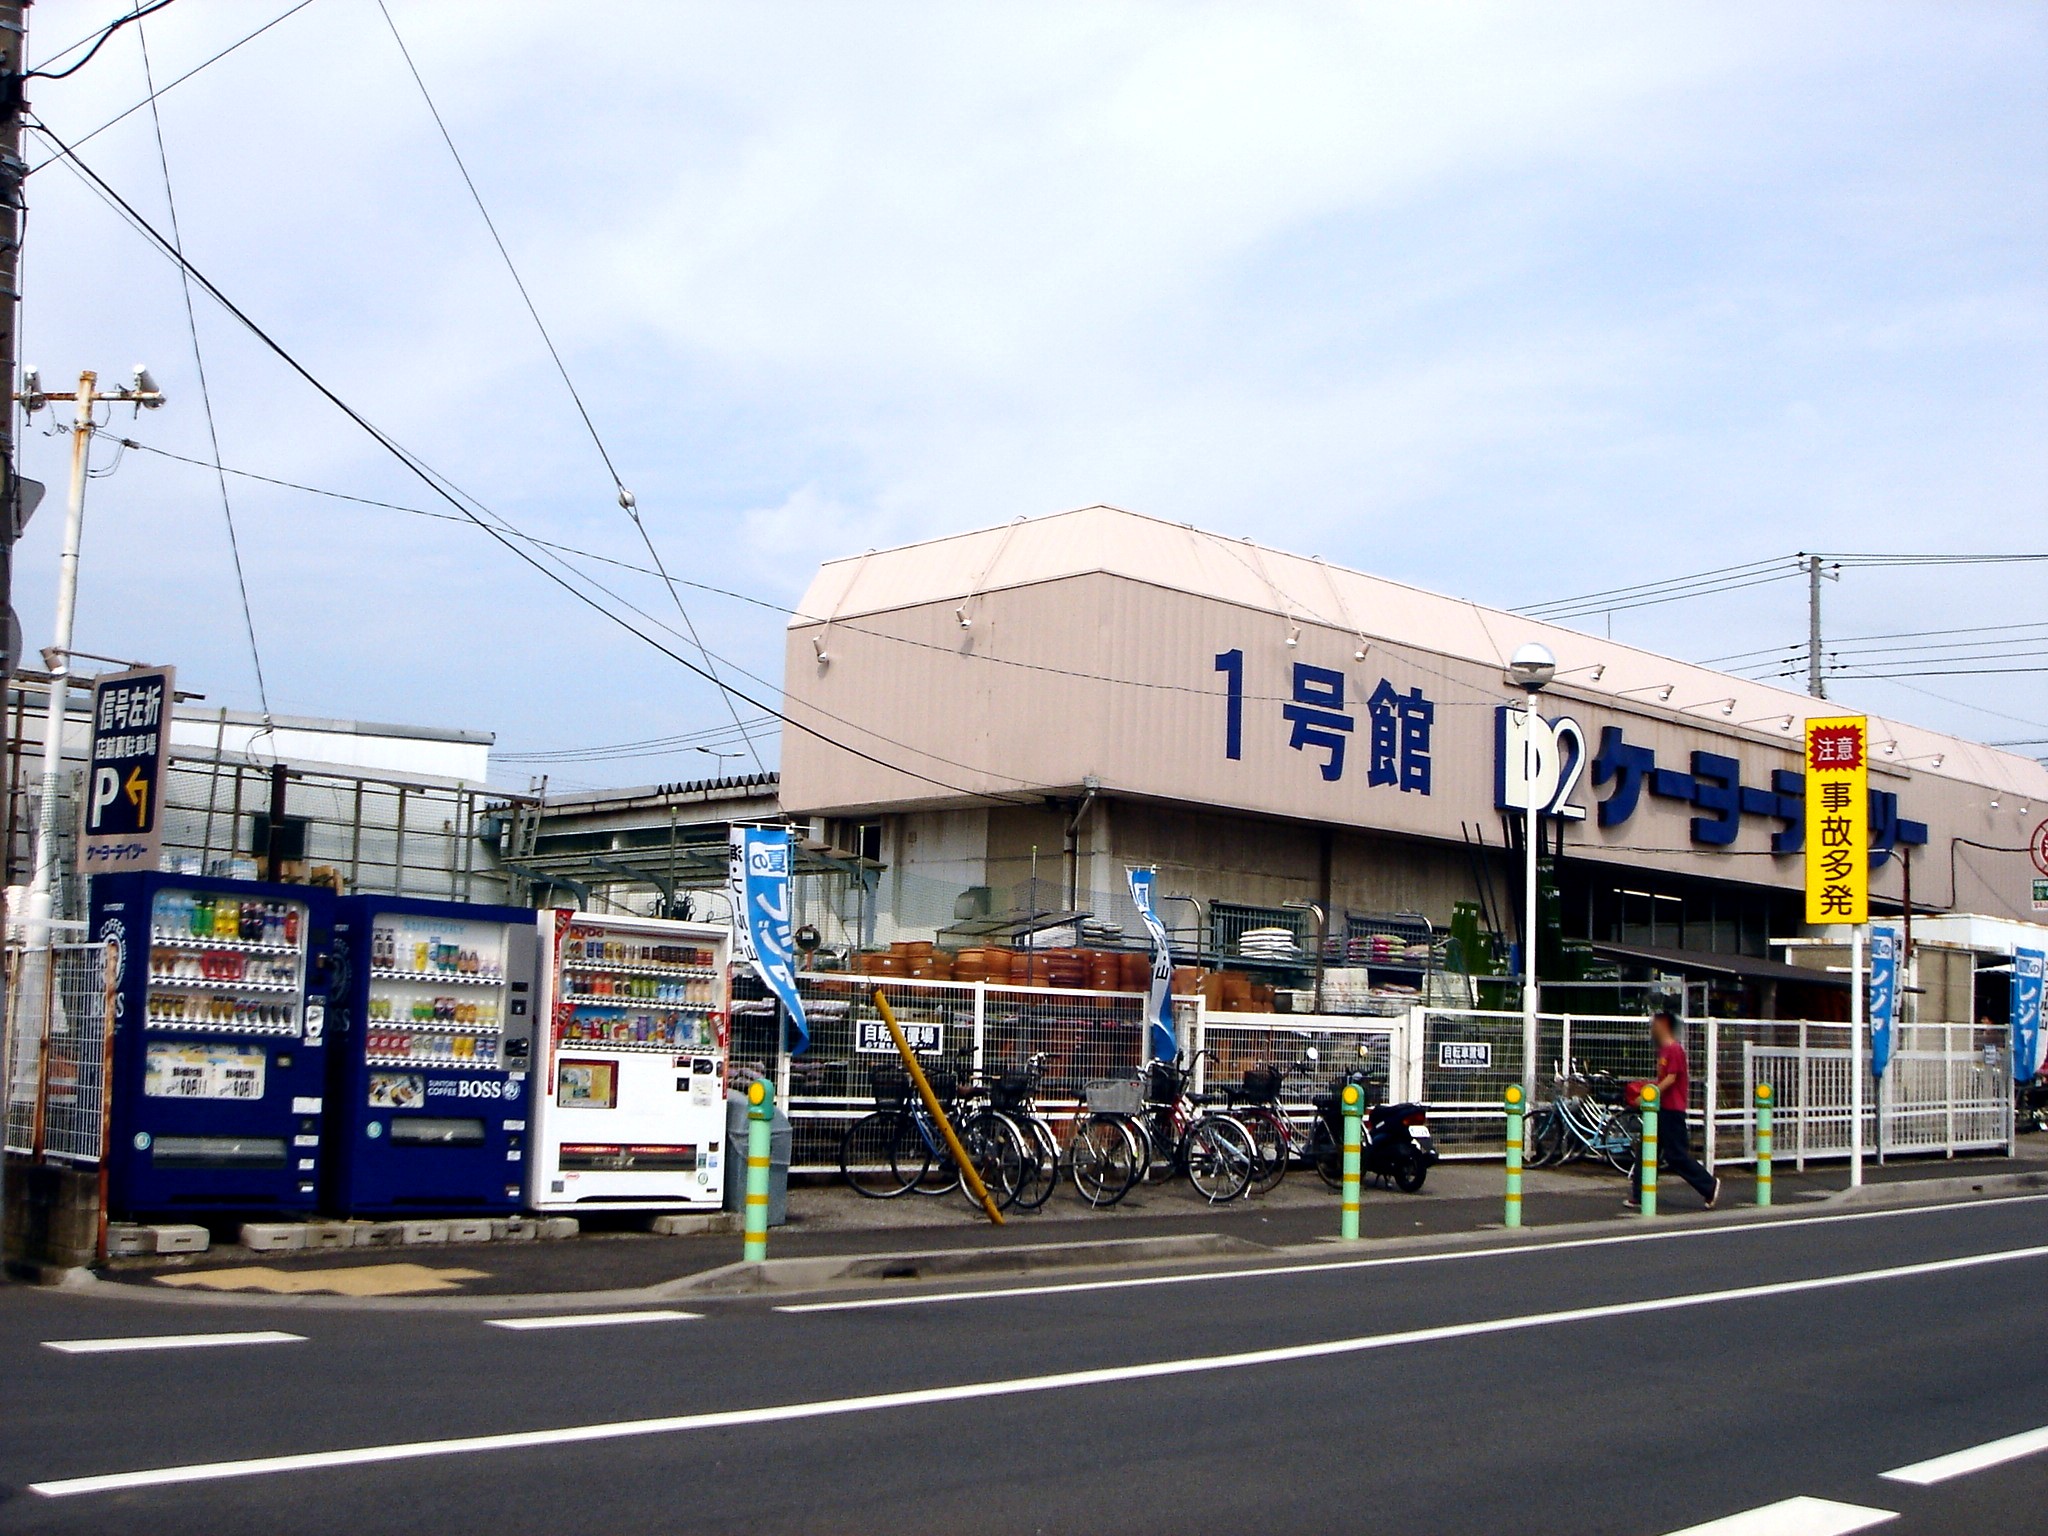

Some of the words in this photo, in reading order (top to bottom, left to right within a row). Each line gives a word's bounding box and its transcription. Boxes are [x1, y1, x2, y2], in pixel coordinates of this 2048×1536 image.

[100, 685, 161, 730] 信号左折
[1215, 648, 1434, 796] 1号館
[1817, 736, 1854, 762] 注意
[91, 767, 119, 828] P
[1820, 781, 1853, 915] 事故多発
[427, 1087, 457, 1096] COFFEE
[458, 1080, 501, 1098] BOSS
